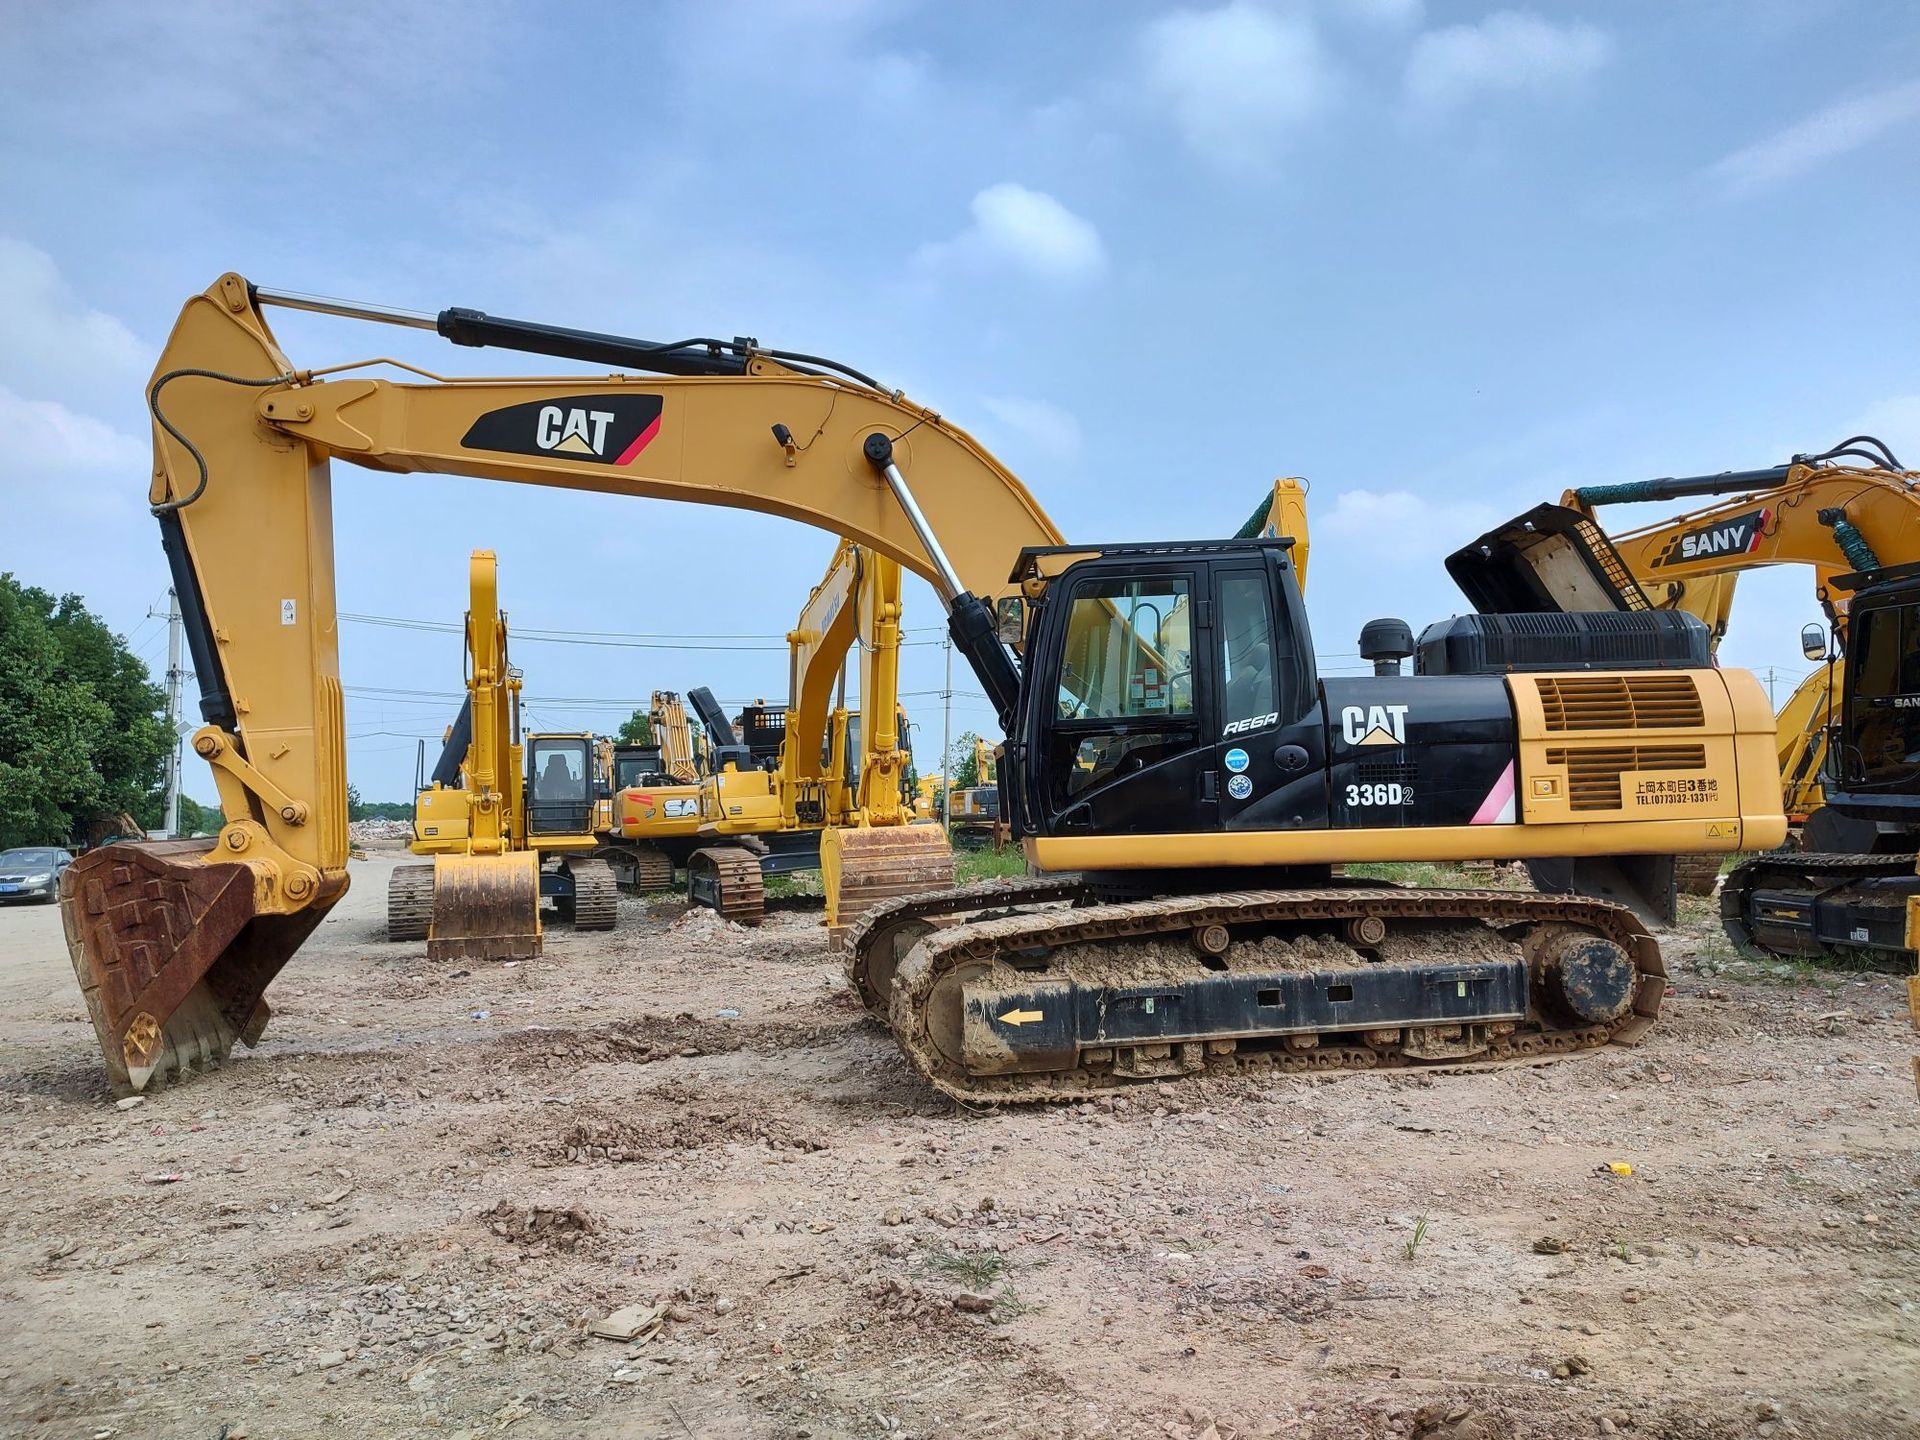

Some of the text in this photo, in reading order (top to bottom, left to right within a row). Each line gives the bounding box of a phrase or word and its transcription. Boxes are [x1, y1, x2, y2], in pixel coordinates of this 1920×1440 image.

[537, 406, 615, 456] CAT
[1682, 525, 1745, 558] SANY
[1894, 697, 1920, 708] SAN
[1342, 705, 1409, 746] CAT
[1346, 783, 1414, 806] 336D2
[664, 800, 698, 818] SA
